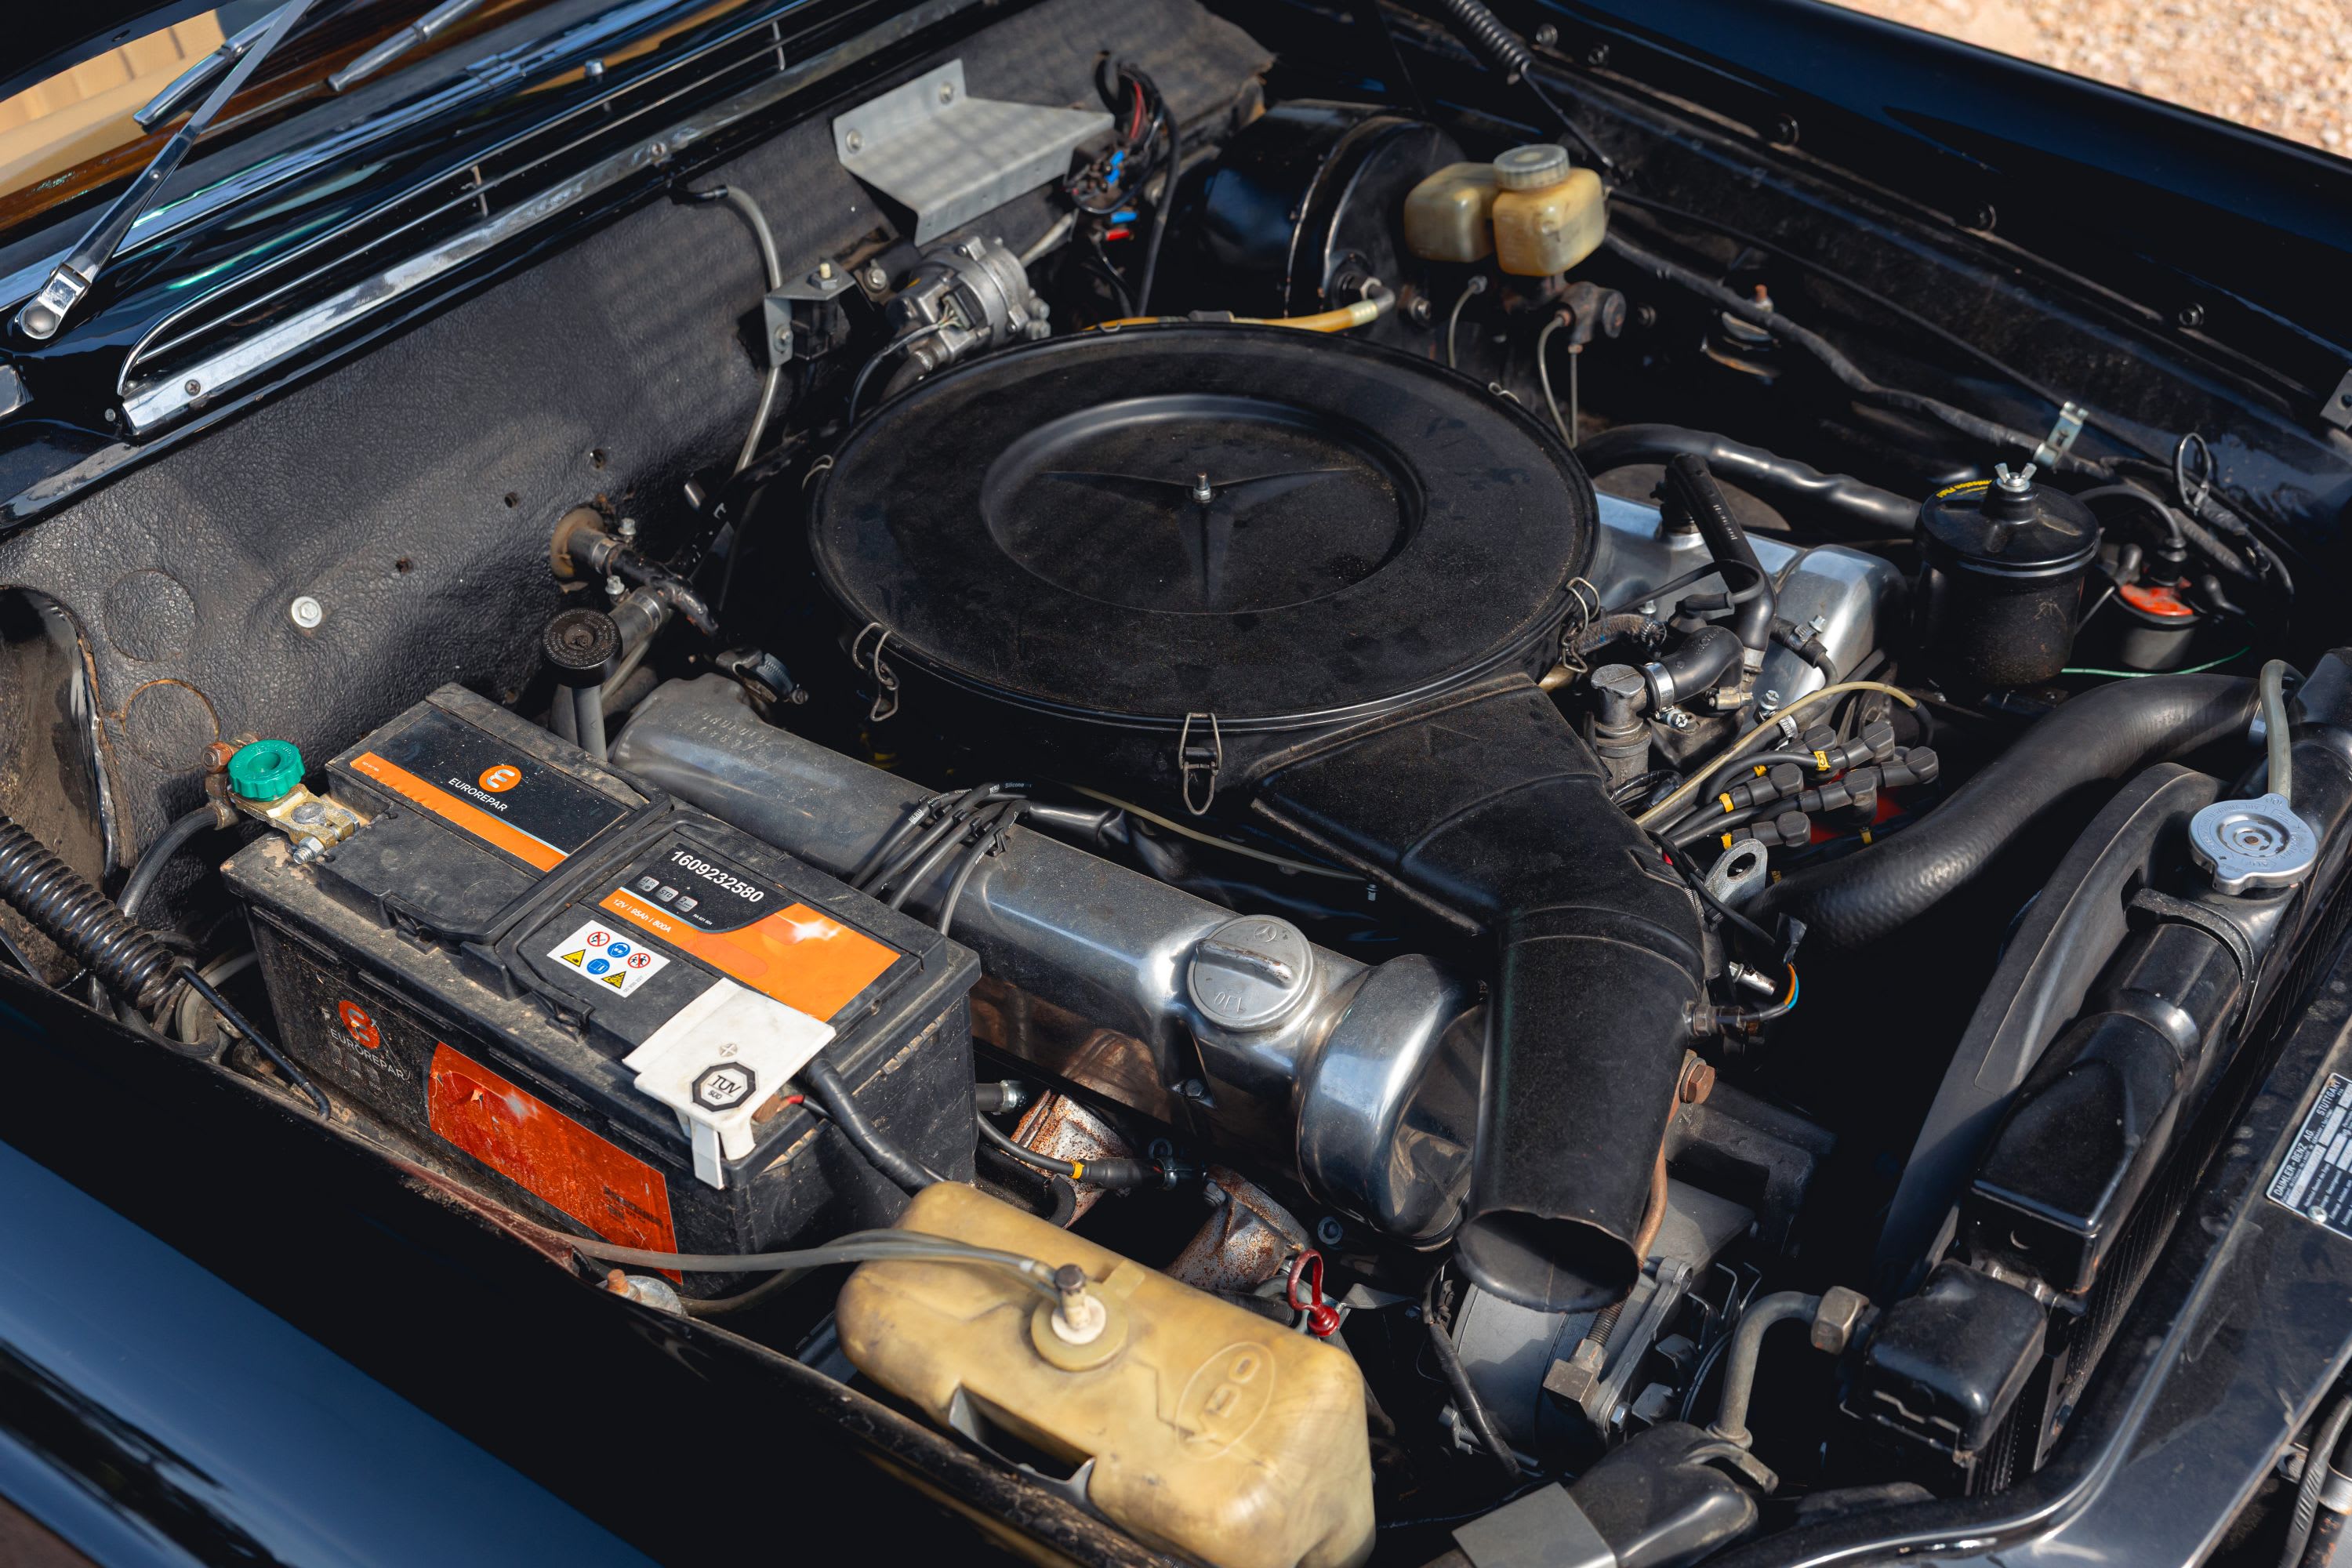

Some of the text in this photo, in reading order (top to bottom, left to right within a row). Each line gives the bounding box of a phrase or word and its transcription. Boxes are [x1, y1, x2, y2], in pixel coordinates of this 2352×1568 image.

[1819, 753, 1825, 765] 5
[448, 778, 508, 812] EUROREPAR
[909, 809, 924, 823] BERU
[659, 887, 674, 899] STD
[670, 850, 764, 903] 1609232580
[612, 897, 628, 909] 12V
[652, 918, 672, 933] 800A
[329, 1028, 406, 1081] EUROREPAR
